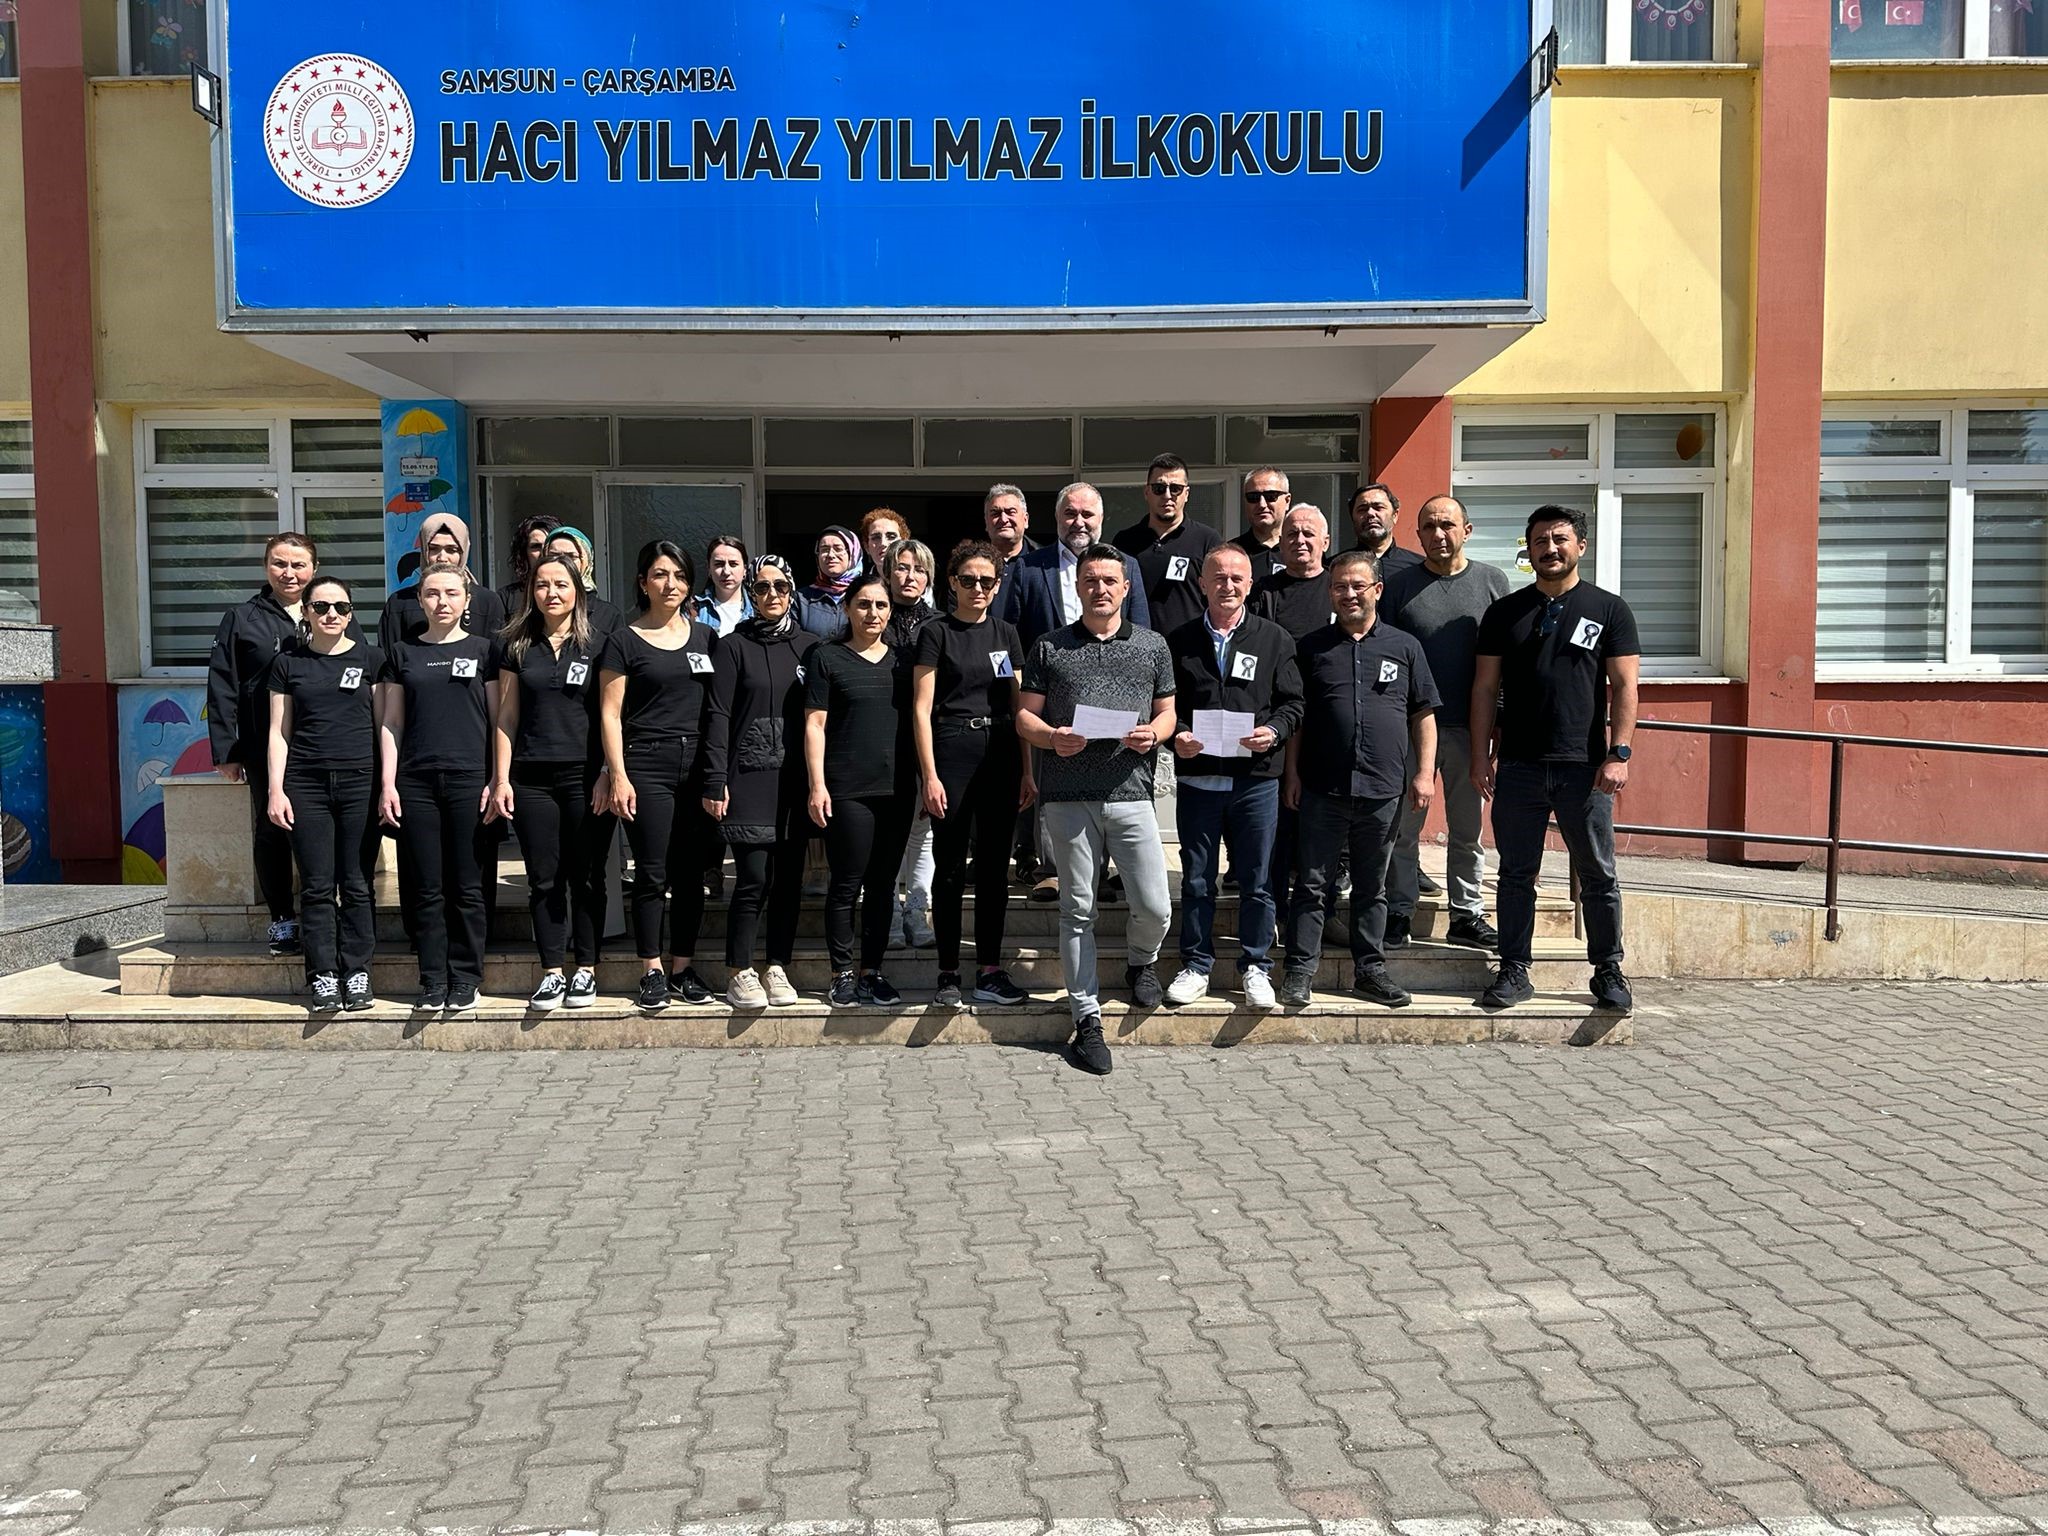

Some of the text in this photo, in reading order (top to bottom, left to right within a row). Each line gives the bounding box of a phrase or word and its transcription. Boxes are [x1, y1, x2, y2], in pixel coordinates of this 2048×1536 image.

[440, 66, 736, 96] SAMSUN - ÇARŞAMBA
[293, 83, 386, 176] TÜRKİYE CUMHURİYETİ MİLLİ EĞİTİM BAKANLIĞI
[440, 98, 1383, 182] HACI YILMAZ YILMAZ İLKOKULU
